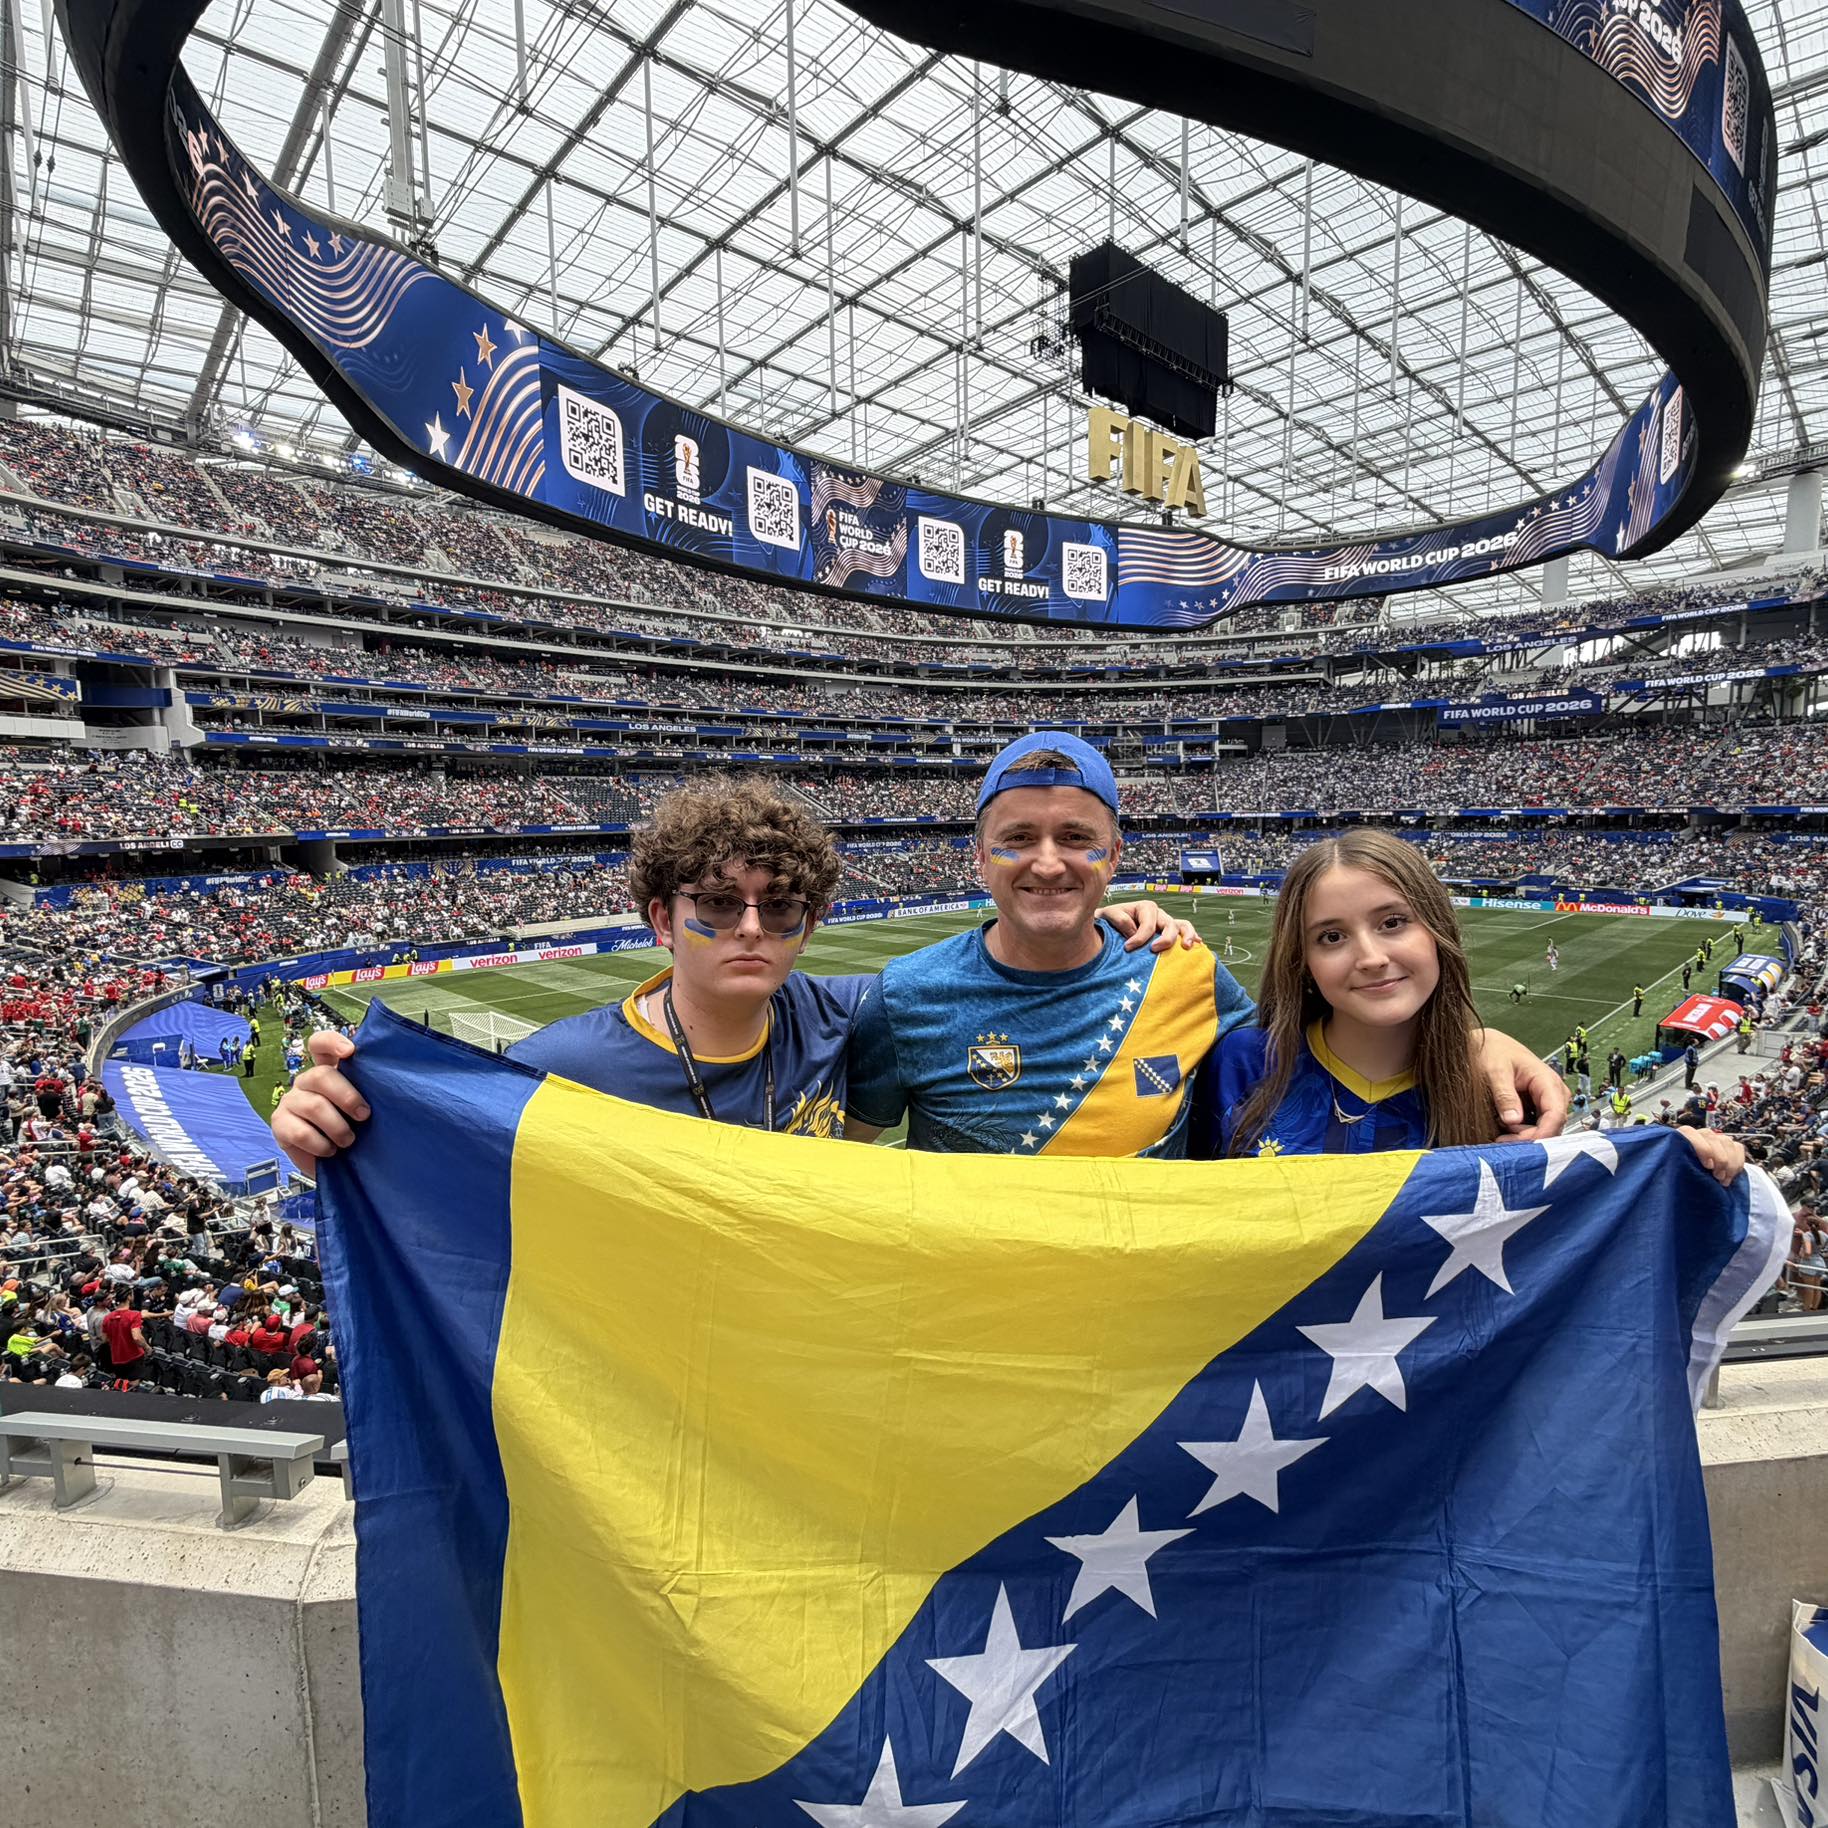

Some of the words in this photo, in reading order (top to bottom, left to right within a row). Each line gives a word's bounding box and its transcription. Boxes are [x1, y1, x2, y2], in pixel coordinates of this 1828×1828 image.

[1639, 1, 1682, 65] 2026
[1088, 407, 1207, 518] FIFA
[676, 490, 701, 505] 2026
[643, 493, 675, 518] GET
[677, 504, 733, 537] READY!
[838, 511, 860, 526] FIFA
[839, 522, 873, 540] WORLD
[839, 535, 859, 549] CUP
[859, 540, 892, 556] 2026
[1324, 566, 1362, 581] FIFA
[1362, 554, 1423, 576] WORLD
[1424, 547, 1460, 565] CUP
[1460, 531, 1519, 559] 2026
[978, 577, 1003, 593] GET
[1004, 581, 1050, 599] READY!
[1661, 614, 1677, 622] FIFA
[1677, 609, 1704, 620] WORLD
[1704, 607, 1721, 616] CUP
[1486, 643, 1513, 653] LOS
[1514, 636, 1578, 650] ANGELES
[1645, 679, 1667, 688] FIFA
[1667, 674, 1704, 686] WORLD
[1704, 672, 1726, 682] CUP
[1726, 668, 1766, 680] 2026
[1506, 691, 1525, 700] LOS
[1526, 688, 1569, 699] ANGELES
[1443, 709, 1470, 720] FIFA
[1471, 703, 1517, 718] WORLD
[1517, 703, 1544, 714] CUP
[1544, 699, 1593, 713] 2026
[628, 723, 650, 731] LOS
[651, 724, 697, 733] ANGELES
[511, 858, 529, 866] FIFA
[571, 855, 596, 863] 2026
[1216, 887, 1244, 896] verizon
[898, 908, 918, 916] BANK
[919, 906, 928, 914] OF
[929, 903, 960, 912] AMERICA
[1481, 899, 1542, 911] Hisense
[1579, 903, 1648, 916] McDonald's
[839, 915, 856, 923] WORLD
[1675, 908, 1706, 919] Dove
[611, 936, 653, 952] Michelob
[470, 953, 518, 969] verizon
[539, 945, 583, 961] verizon
[120, 1065, 163, 1098] 2026
[130, 1095, 173, 1117] CUP
[140, 1115, 201, 1152] WORLD
[168, 1153, 228, 1179] FIFA
